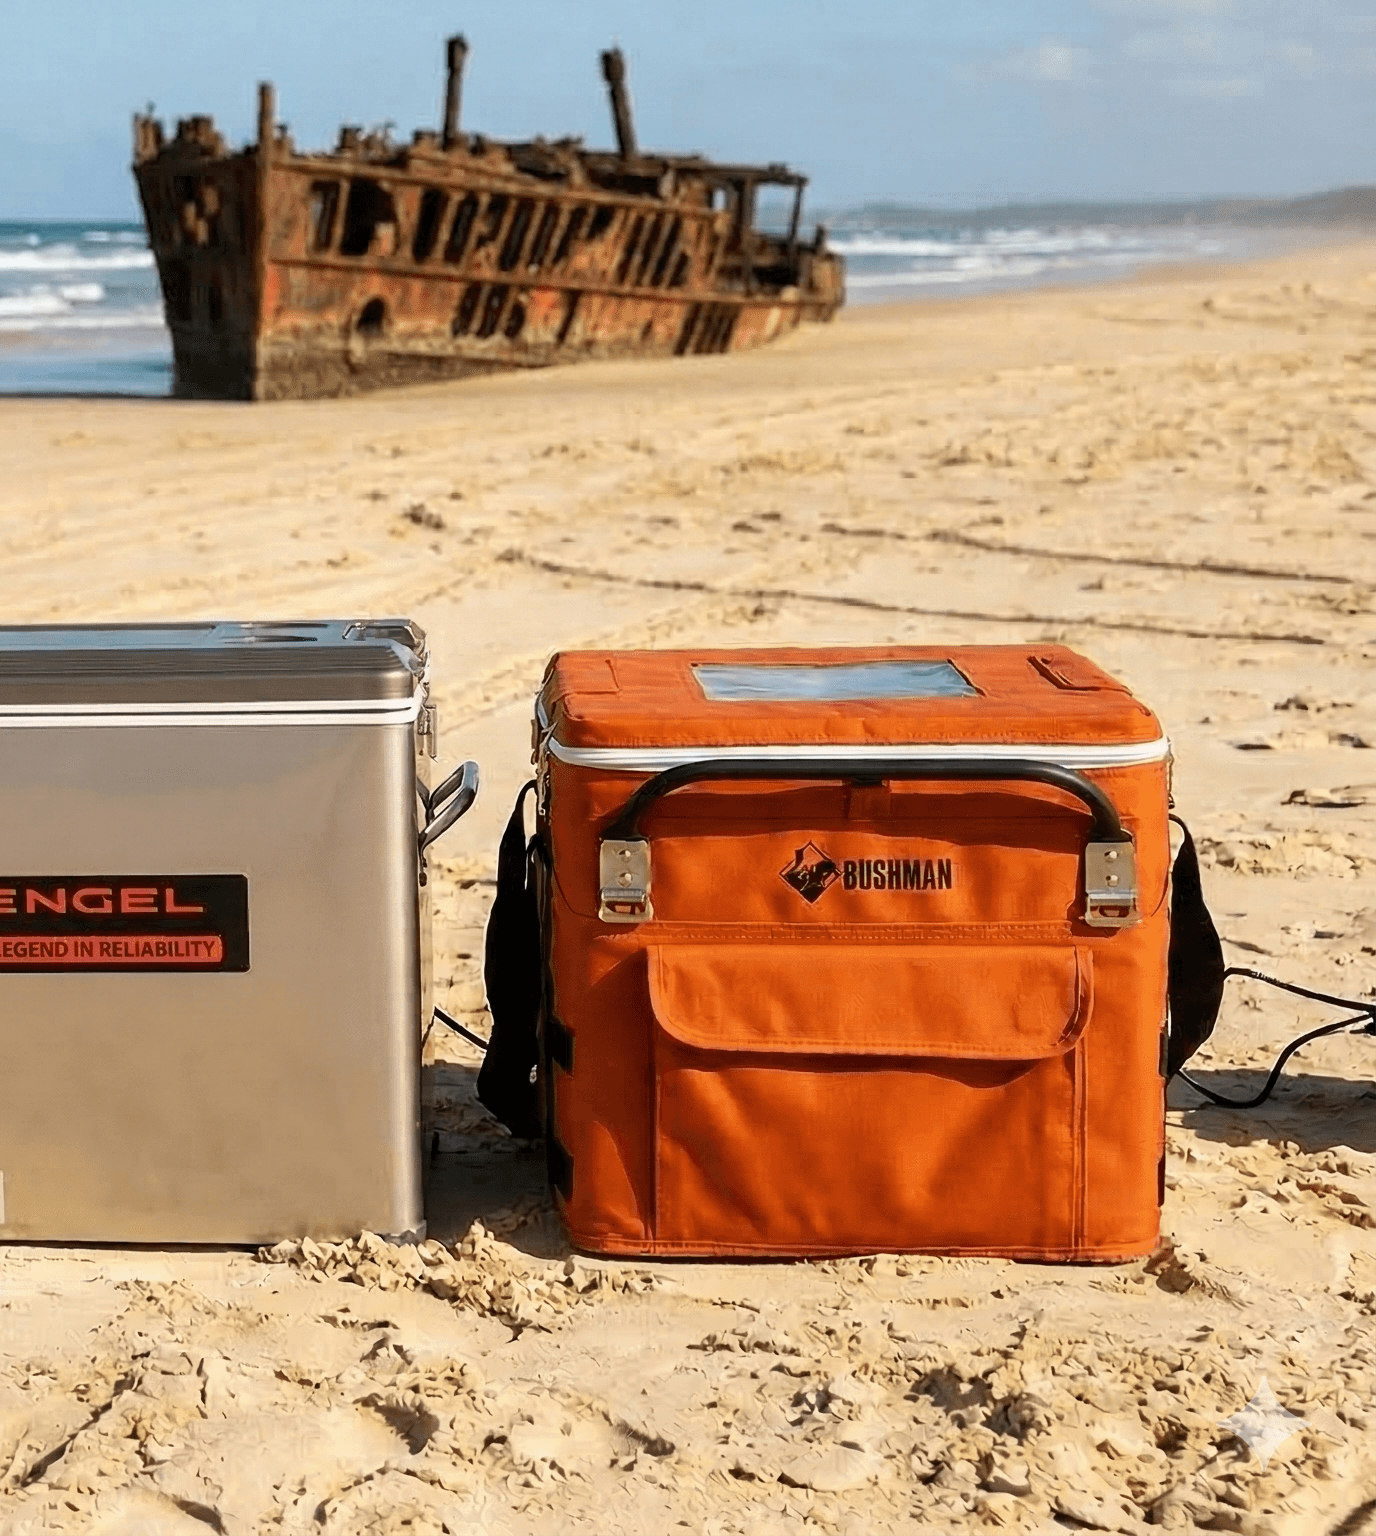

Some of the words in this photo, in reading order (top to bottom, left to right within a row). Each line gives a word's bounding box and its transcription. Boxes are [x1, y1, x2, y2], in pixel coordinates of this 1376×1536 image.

[843, 858, 953, 890] BUSHMAN
[74, 941, 94, 957] IN
[99, 940, 216, 957] RELIABILITY
